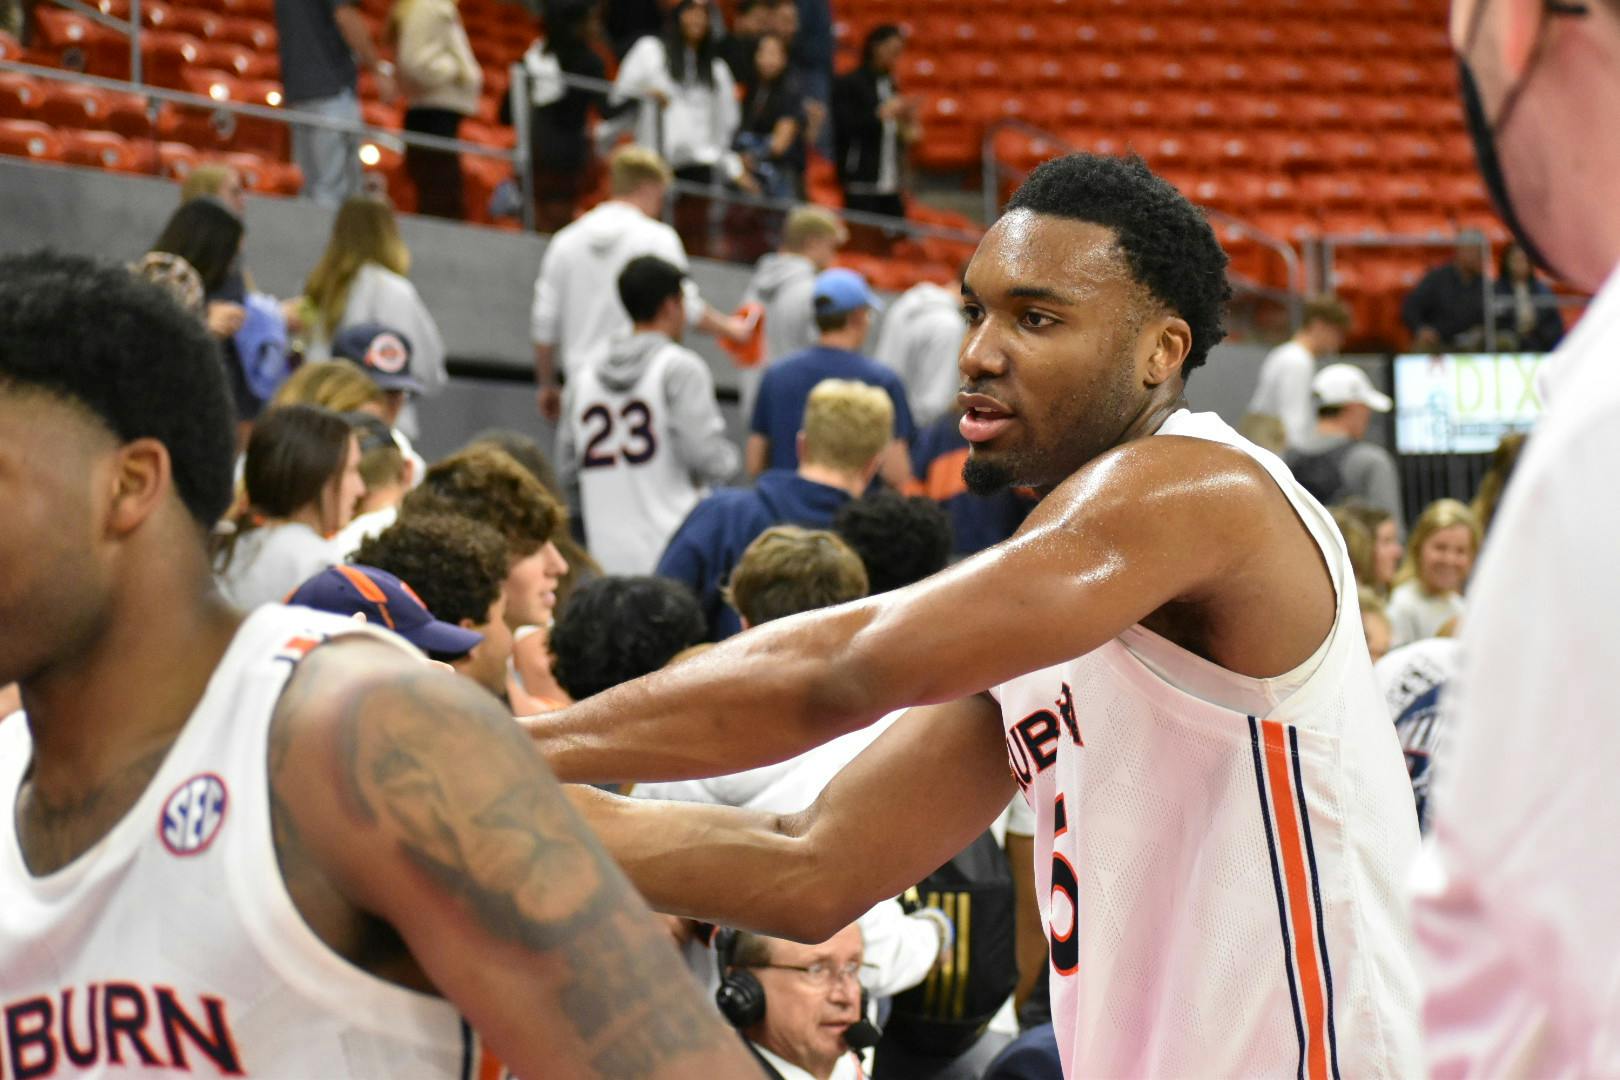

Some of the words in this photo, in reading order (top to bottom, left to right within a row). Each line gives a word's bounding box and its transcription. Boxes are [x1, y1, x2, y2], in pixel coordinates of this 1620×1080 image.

[580, 401, 656, 468] 23
[161, 775, 227, 853] SEC
[0, 978, 247, 1080] BURN
